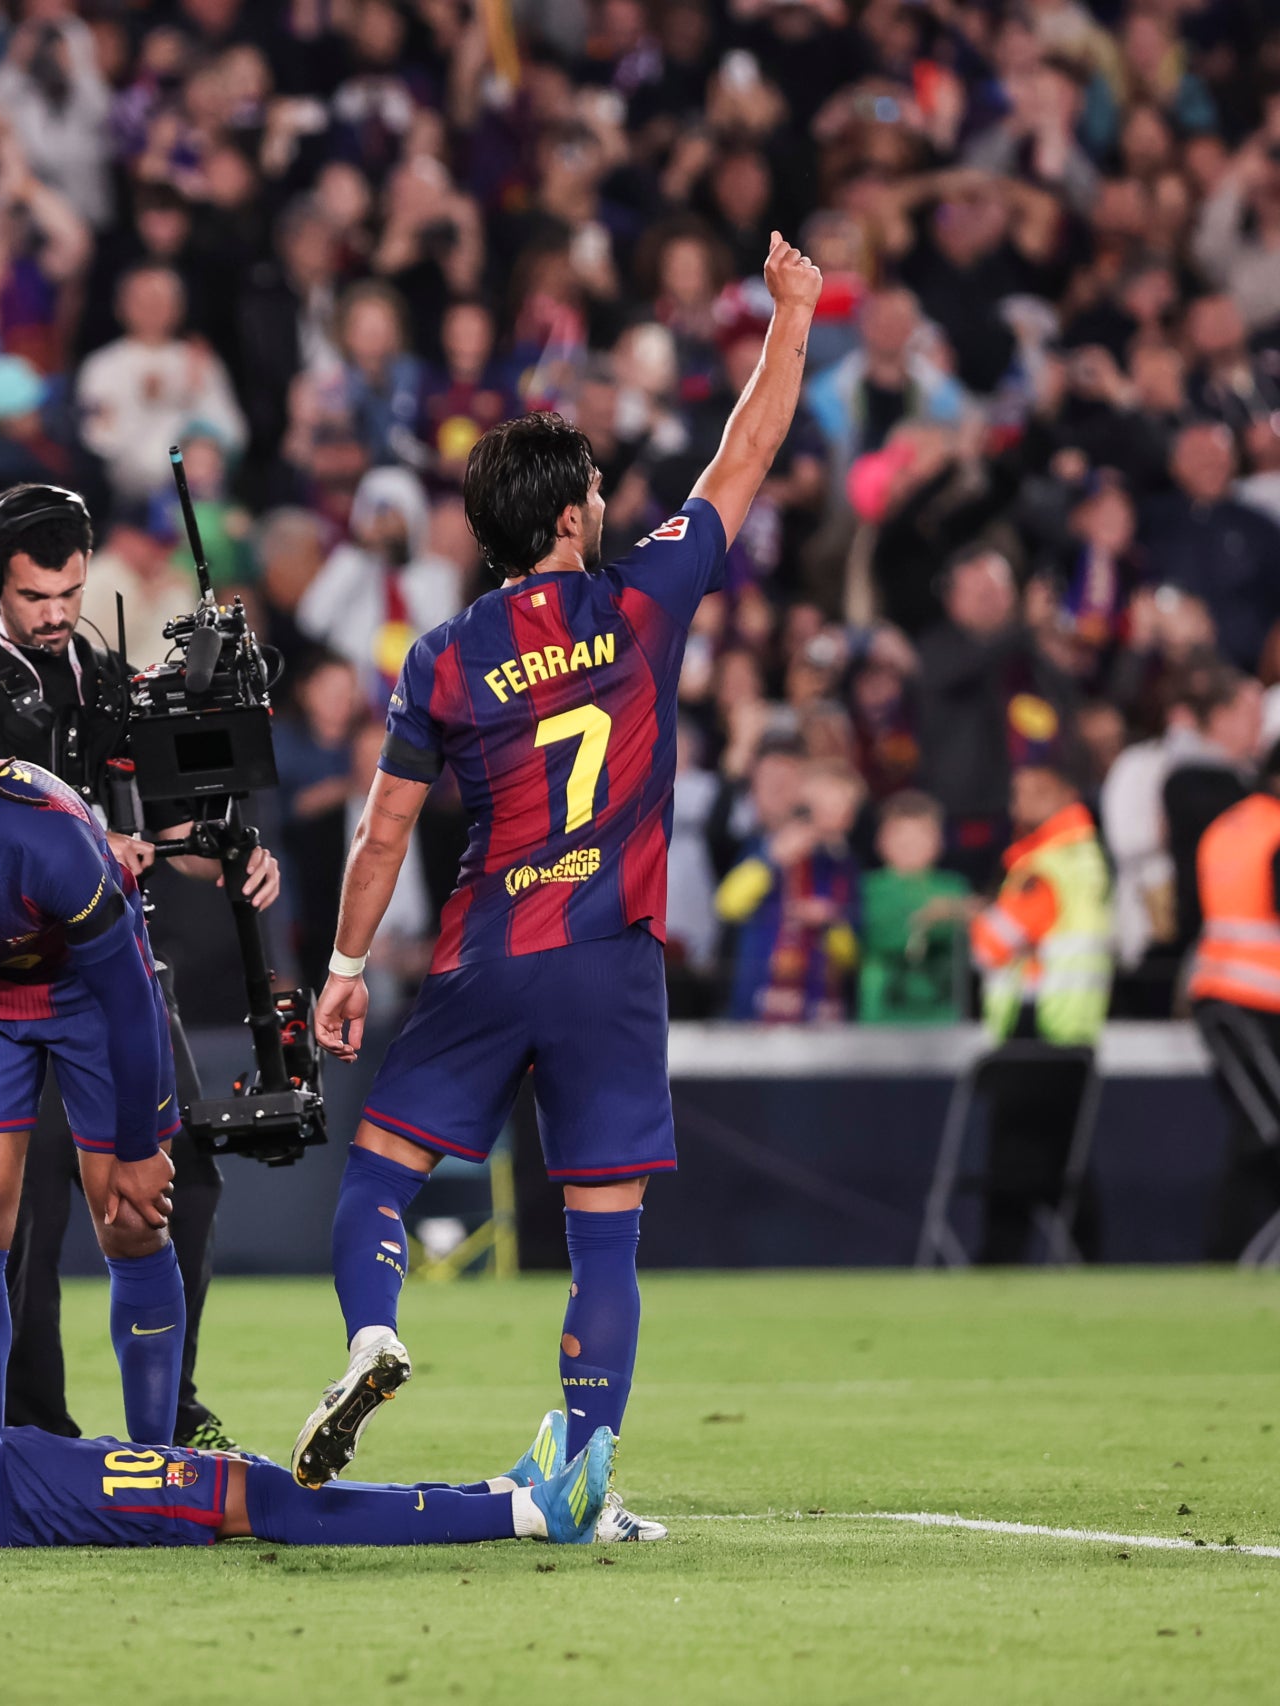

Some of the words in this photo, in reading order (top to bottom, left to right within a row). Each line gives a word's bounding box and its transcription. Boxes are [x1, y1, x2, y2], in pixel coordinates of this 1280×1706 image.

[483, 633, 615, 703] FERRAN
[533, 703, 612, 834] 7
[562, 1377, 609, 1388] BARÇA
[102, 1449, 165, 1497] 10
